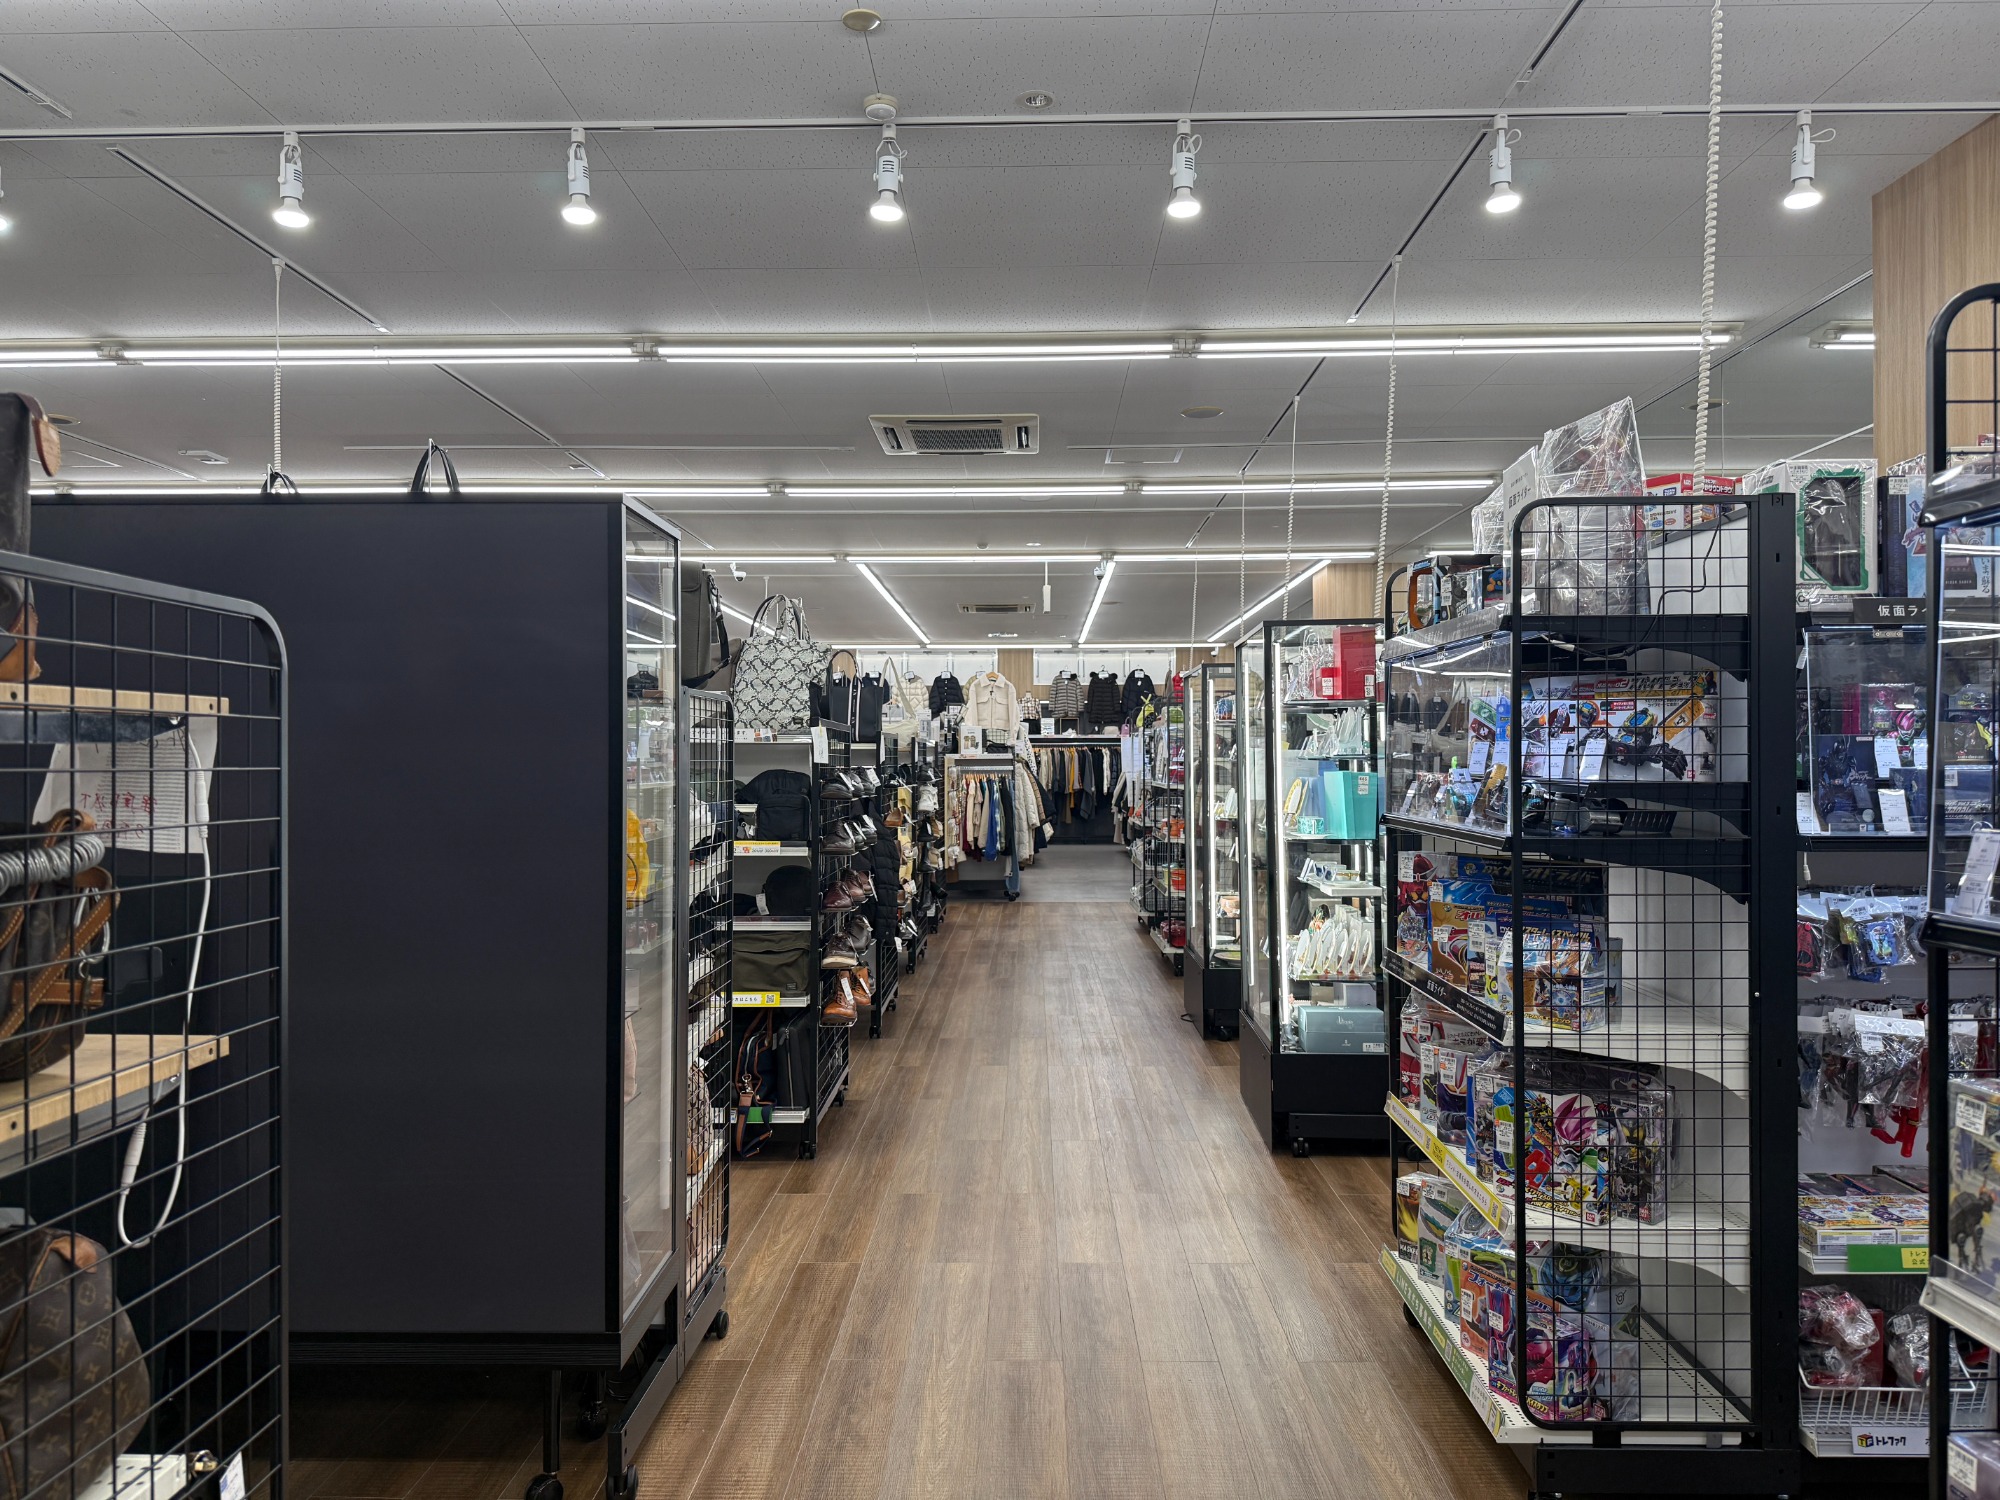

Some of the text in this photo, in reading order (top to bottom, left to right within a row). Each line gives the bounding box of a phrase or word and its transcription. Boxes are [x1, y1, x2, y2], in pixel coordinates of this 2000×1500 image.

[1877, 604, 1956, 617] 仮面ラー
[1876, 1436, 1906, 1446] トレファク
